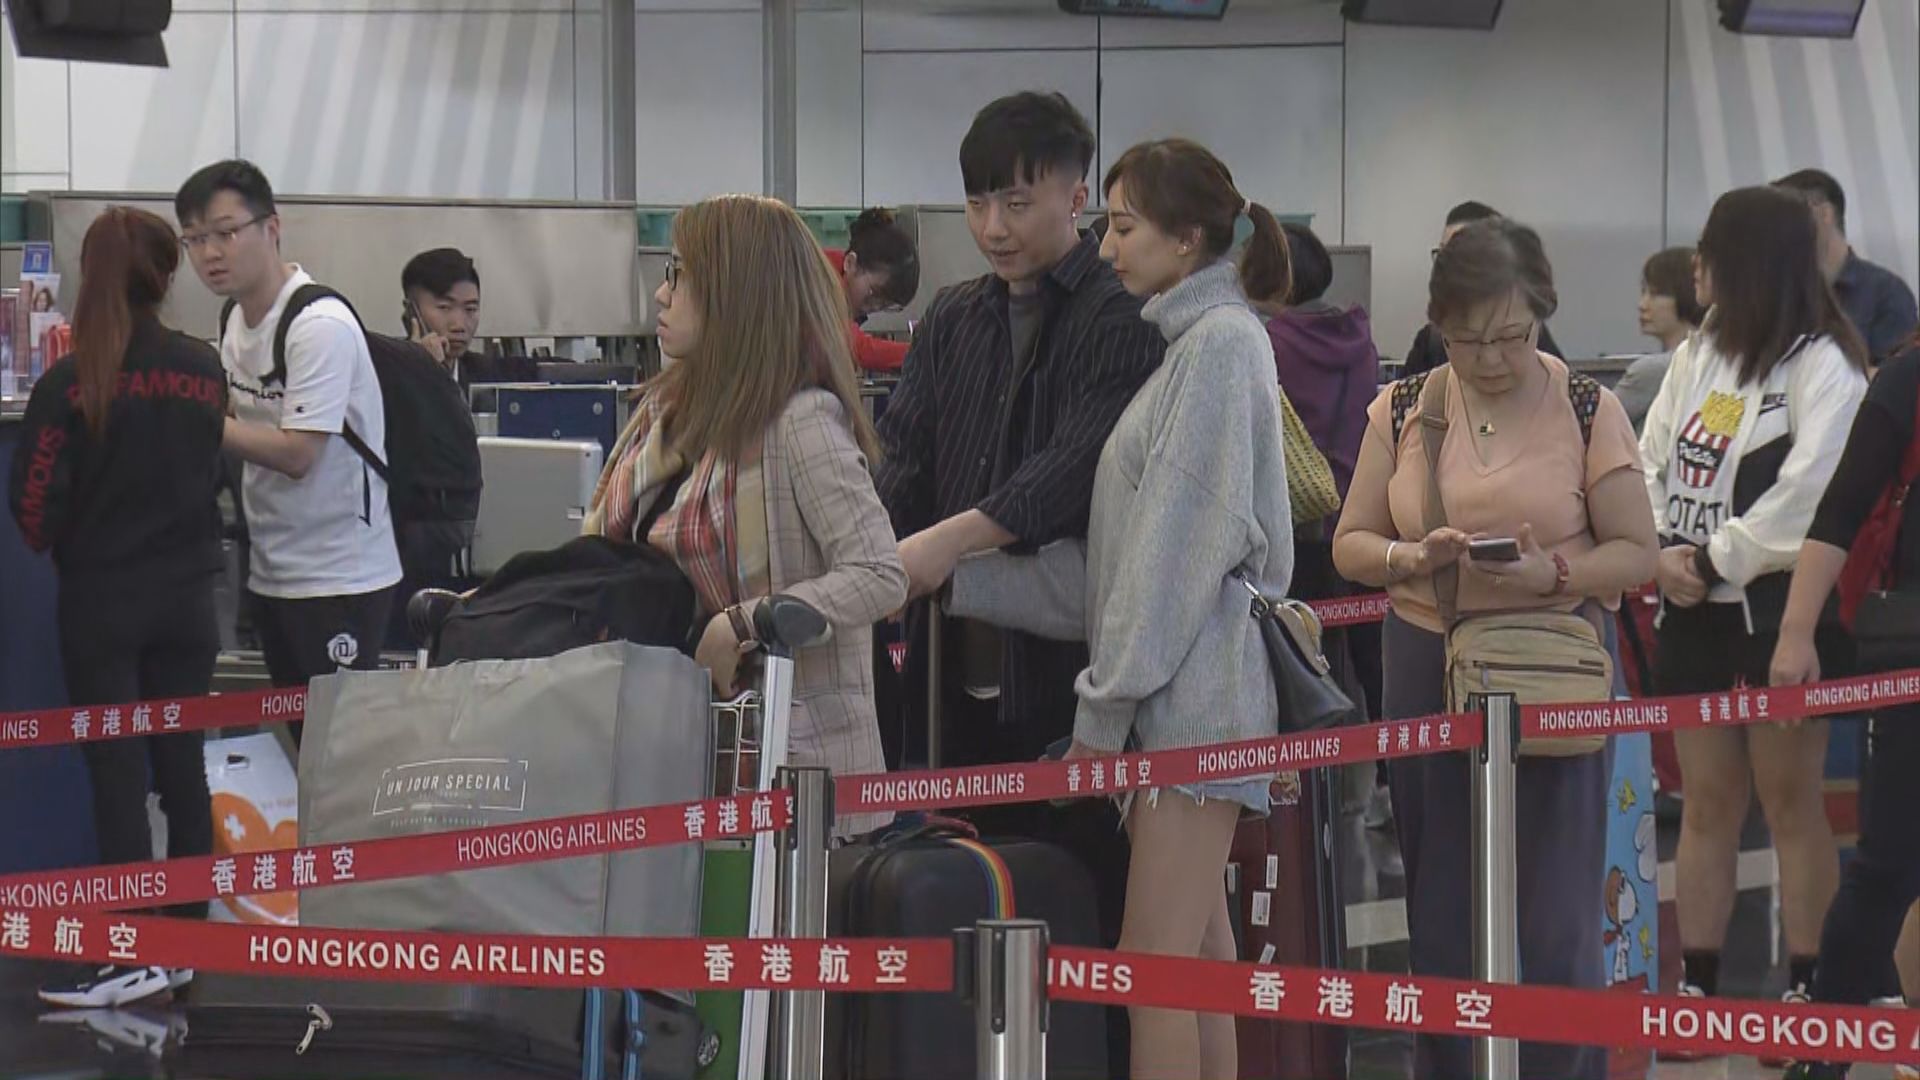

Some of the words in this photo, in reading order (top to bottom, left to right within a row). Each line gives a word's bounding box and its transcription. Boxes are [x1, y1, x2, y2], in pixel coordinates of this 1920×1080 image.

[1668, 494, 1729, 536] OTAT
[1316, 600, 1360, 620] HONGKONG
[1360, 598, 1390, 617] AIRLINE
[261, 694, 308, 715] HONG
[1700, 692, 1769, 722] 香港航空
[1805, 684, 1870, 706] HONGKONG
[0, 719, 39, 740] INES
[71, 702, 182, 740] 香港航空
[1539, 708, 1611, 730] HONGKONG
[1613, 705, 1668, 726] AIRLINES
[1377, 720, 1451, 753] 香港航空
[1198, 745, 1277, 773] HONGKONG
[1279, 737, 1341, 763] AIRLINES
[386, 781, 403, 796] UN
[406, 776, 439, 793] JOUR
[445, 774, 512, 792] SPECIAL
[861, 778, 952, 804] HONGKONG
[955, 772, 1025, 797] AIRLINES
[1067, 758, 1152, 792] 香港航空
[457, 825, 564, 862] HONGKONG
[567, 816, 647, 849] AIRLINES
[72, 871, 167, 905] AIRLINES
[211, 846, 356, 895] 香港航空
[1, 911, 138, 959] 港航空
[249, 935, 441, 971] HONGKONG
[450, 943, 606, 976] AIRLINES
[703, 943, 908, 984] 香港航空
[1047, 957, 1133, 993] INES
[1249, 970, 1493, 1030] 香港航空
[1642, 1006, 1897, 1051] HONGKONG
